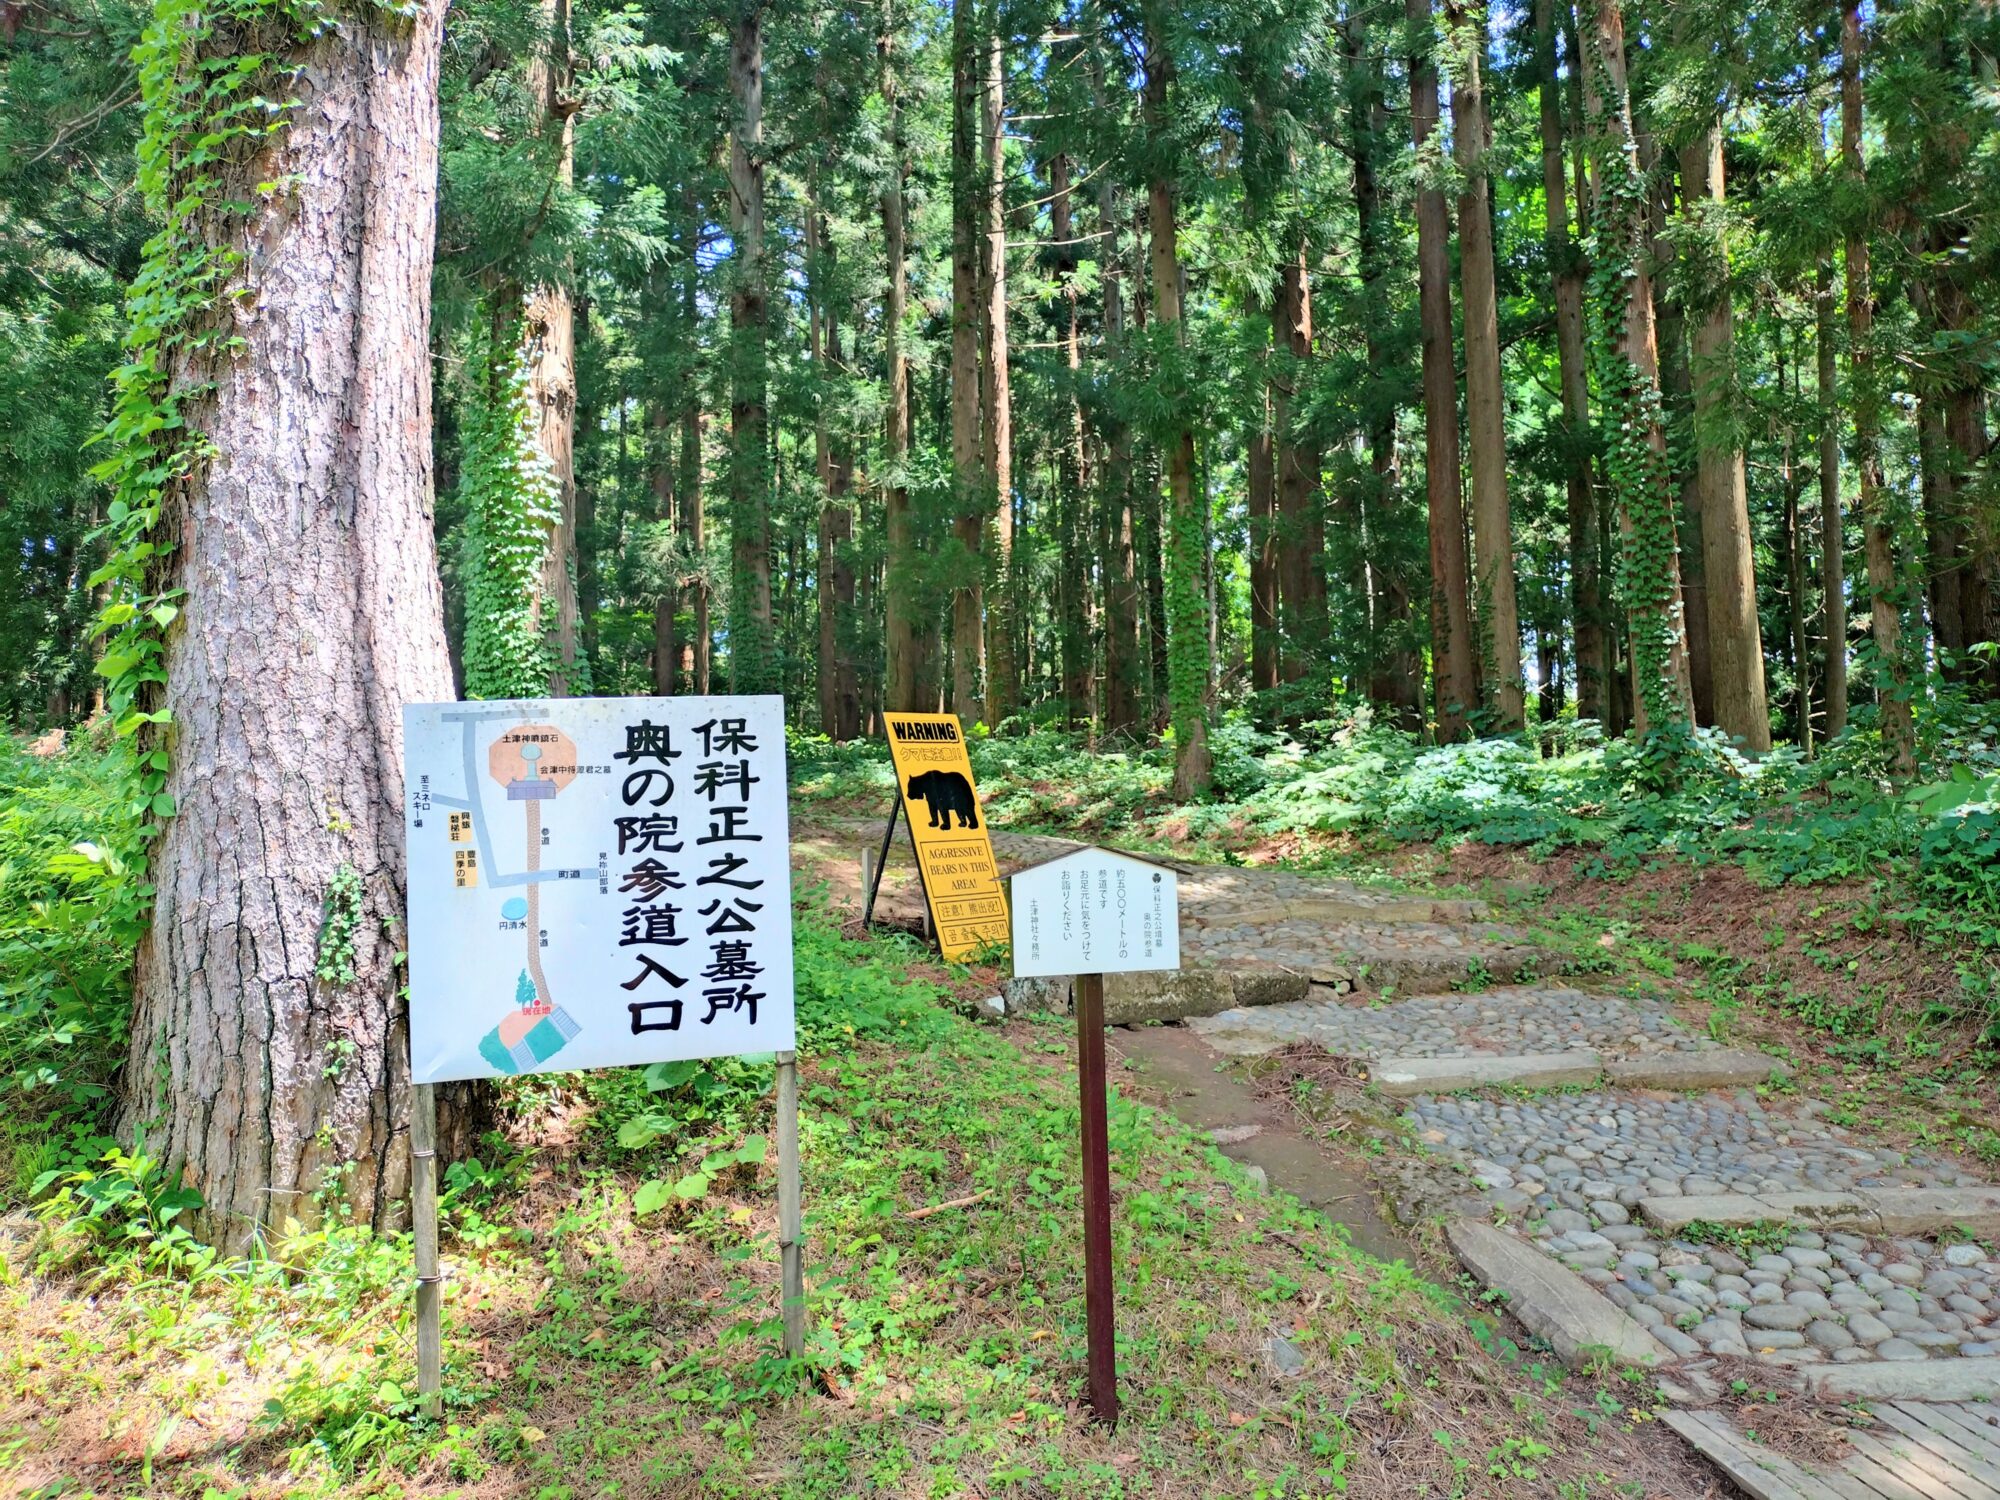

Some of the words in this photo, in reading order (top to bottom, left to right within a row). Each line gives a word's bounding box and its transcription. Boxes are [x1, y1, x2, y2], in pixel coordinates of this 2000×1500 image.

[893, 722, 957, 741] WARNING
[413, 792, 423, 828] スキー場
[541, 828, 550, 845] 参道
[929, 846, 984, 859] AGGRESSIVE
[456, 850, 466, 887] 四季の里
[558, 870, 581, 879] 町道
[613, 719, 690, 1035] 奥の院参道入口
[692, 718, 767, 1025] 保科正之公墓所
[930, 864, 957, 876] BEARS
[959, 863, 968, 873] IN
[970, 861, 990, 872] THIS
[952, 879, 977, 890] AREA!
[1098, 869, 1107, 909] 参道です
[1080, 870, 1090, 961] お足元に気をつけて
[499, 921, 527, 930] 円清水
[539, 930, 548, 947] 参道
[523, 1007, 551, 1015] 現在地
